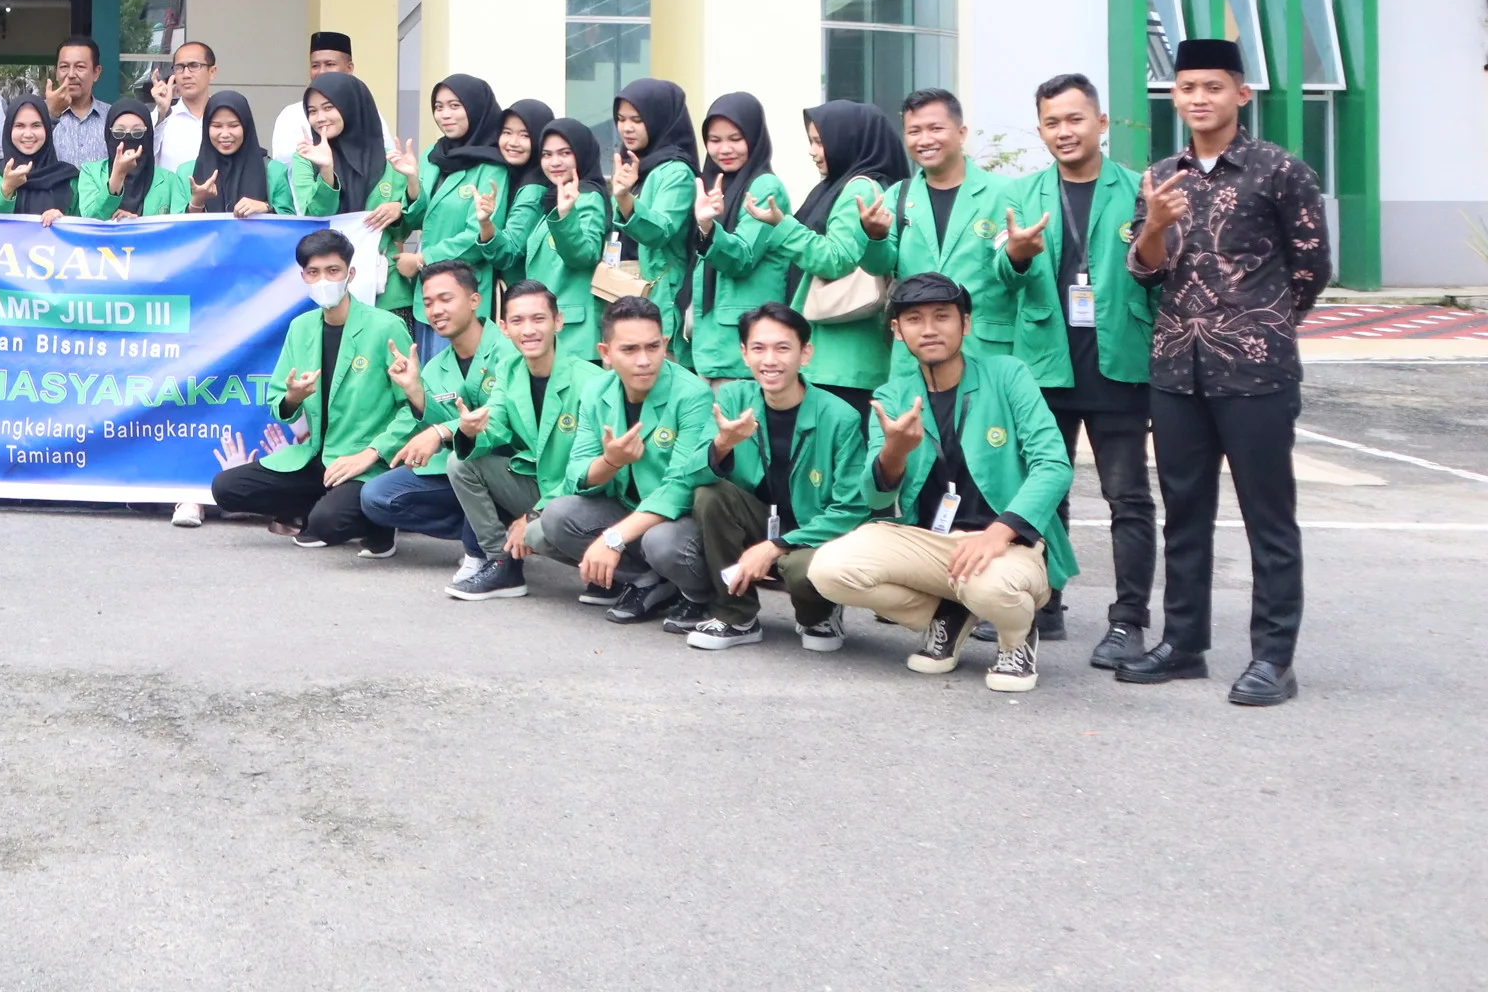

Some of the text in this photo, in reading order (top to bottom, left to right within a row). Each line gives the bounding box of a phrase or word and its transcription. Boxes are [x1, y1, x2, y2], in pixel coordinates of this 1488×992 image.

[59, 301, 135, 325] JILID
[145, 302, 171, 326] III
[36, 334, 107, 357] Bisnis
[120, 338, 181, 358] Islam
[104, 420, 232, 443] Balingkarang
[7, 445, 86, 467] Tamiang
